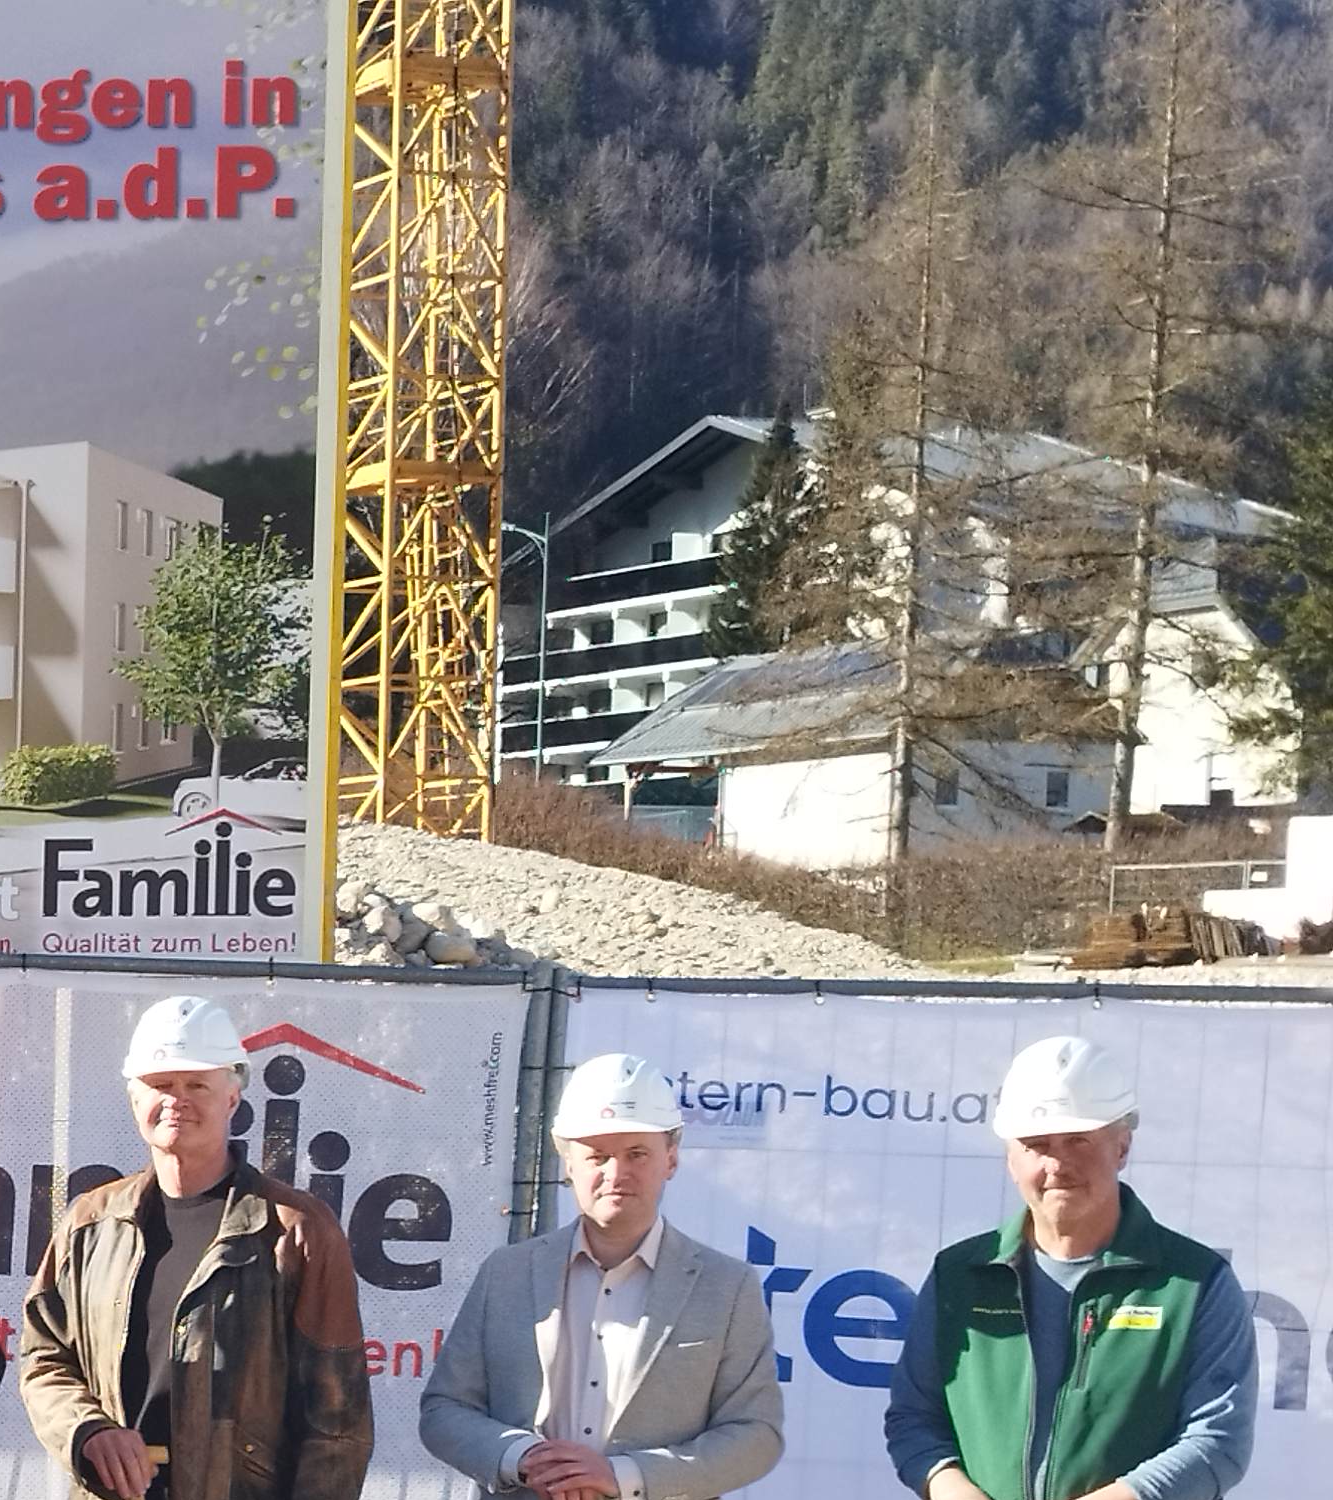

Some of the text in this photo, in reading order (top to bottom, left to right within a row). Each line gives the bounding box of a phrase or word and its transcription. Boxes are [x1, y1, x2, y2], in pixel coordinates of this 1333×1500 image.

[223, 58, 299, 129] in
[32, 144, 297, 222] a.d.P.
[42, 821, 297, 918] Familie
[41, 931, 297, 953] Qualität zum Leben!
[664, 1070, 1001, 1124] tern-bau.a
